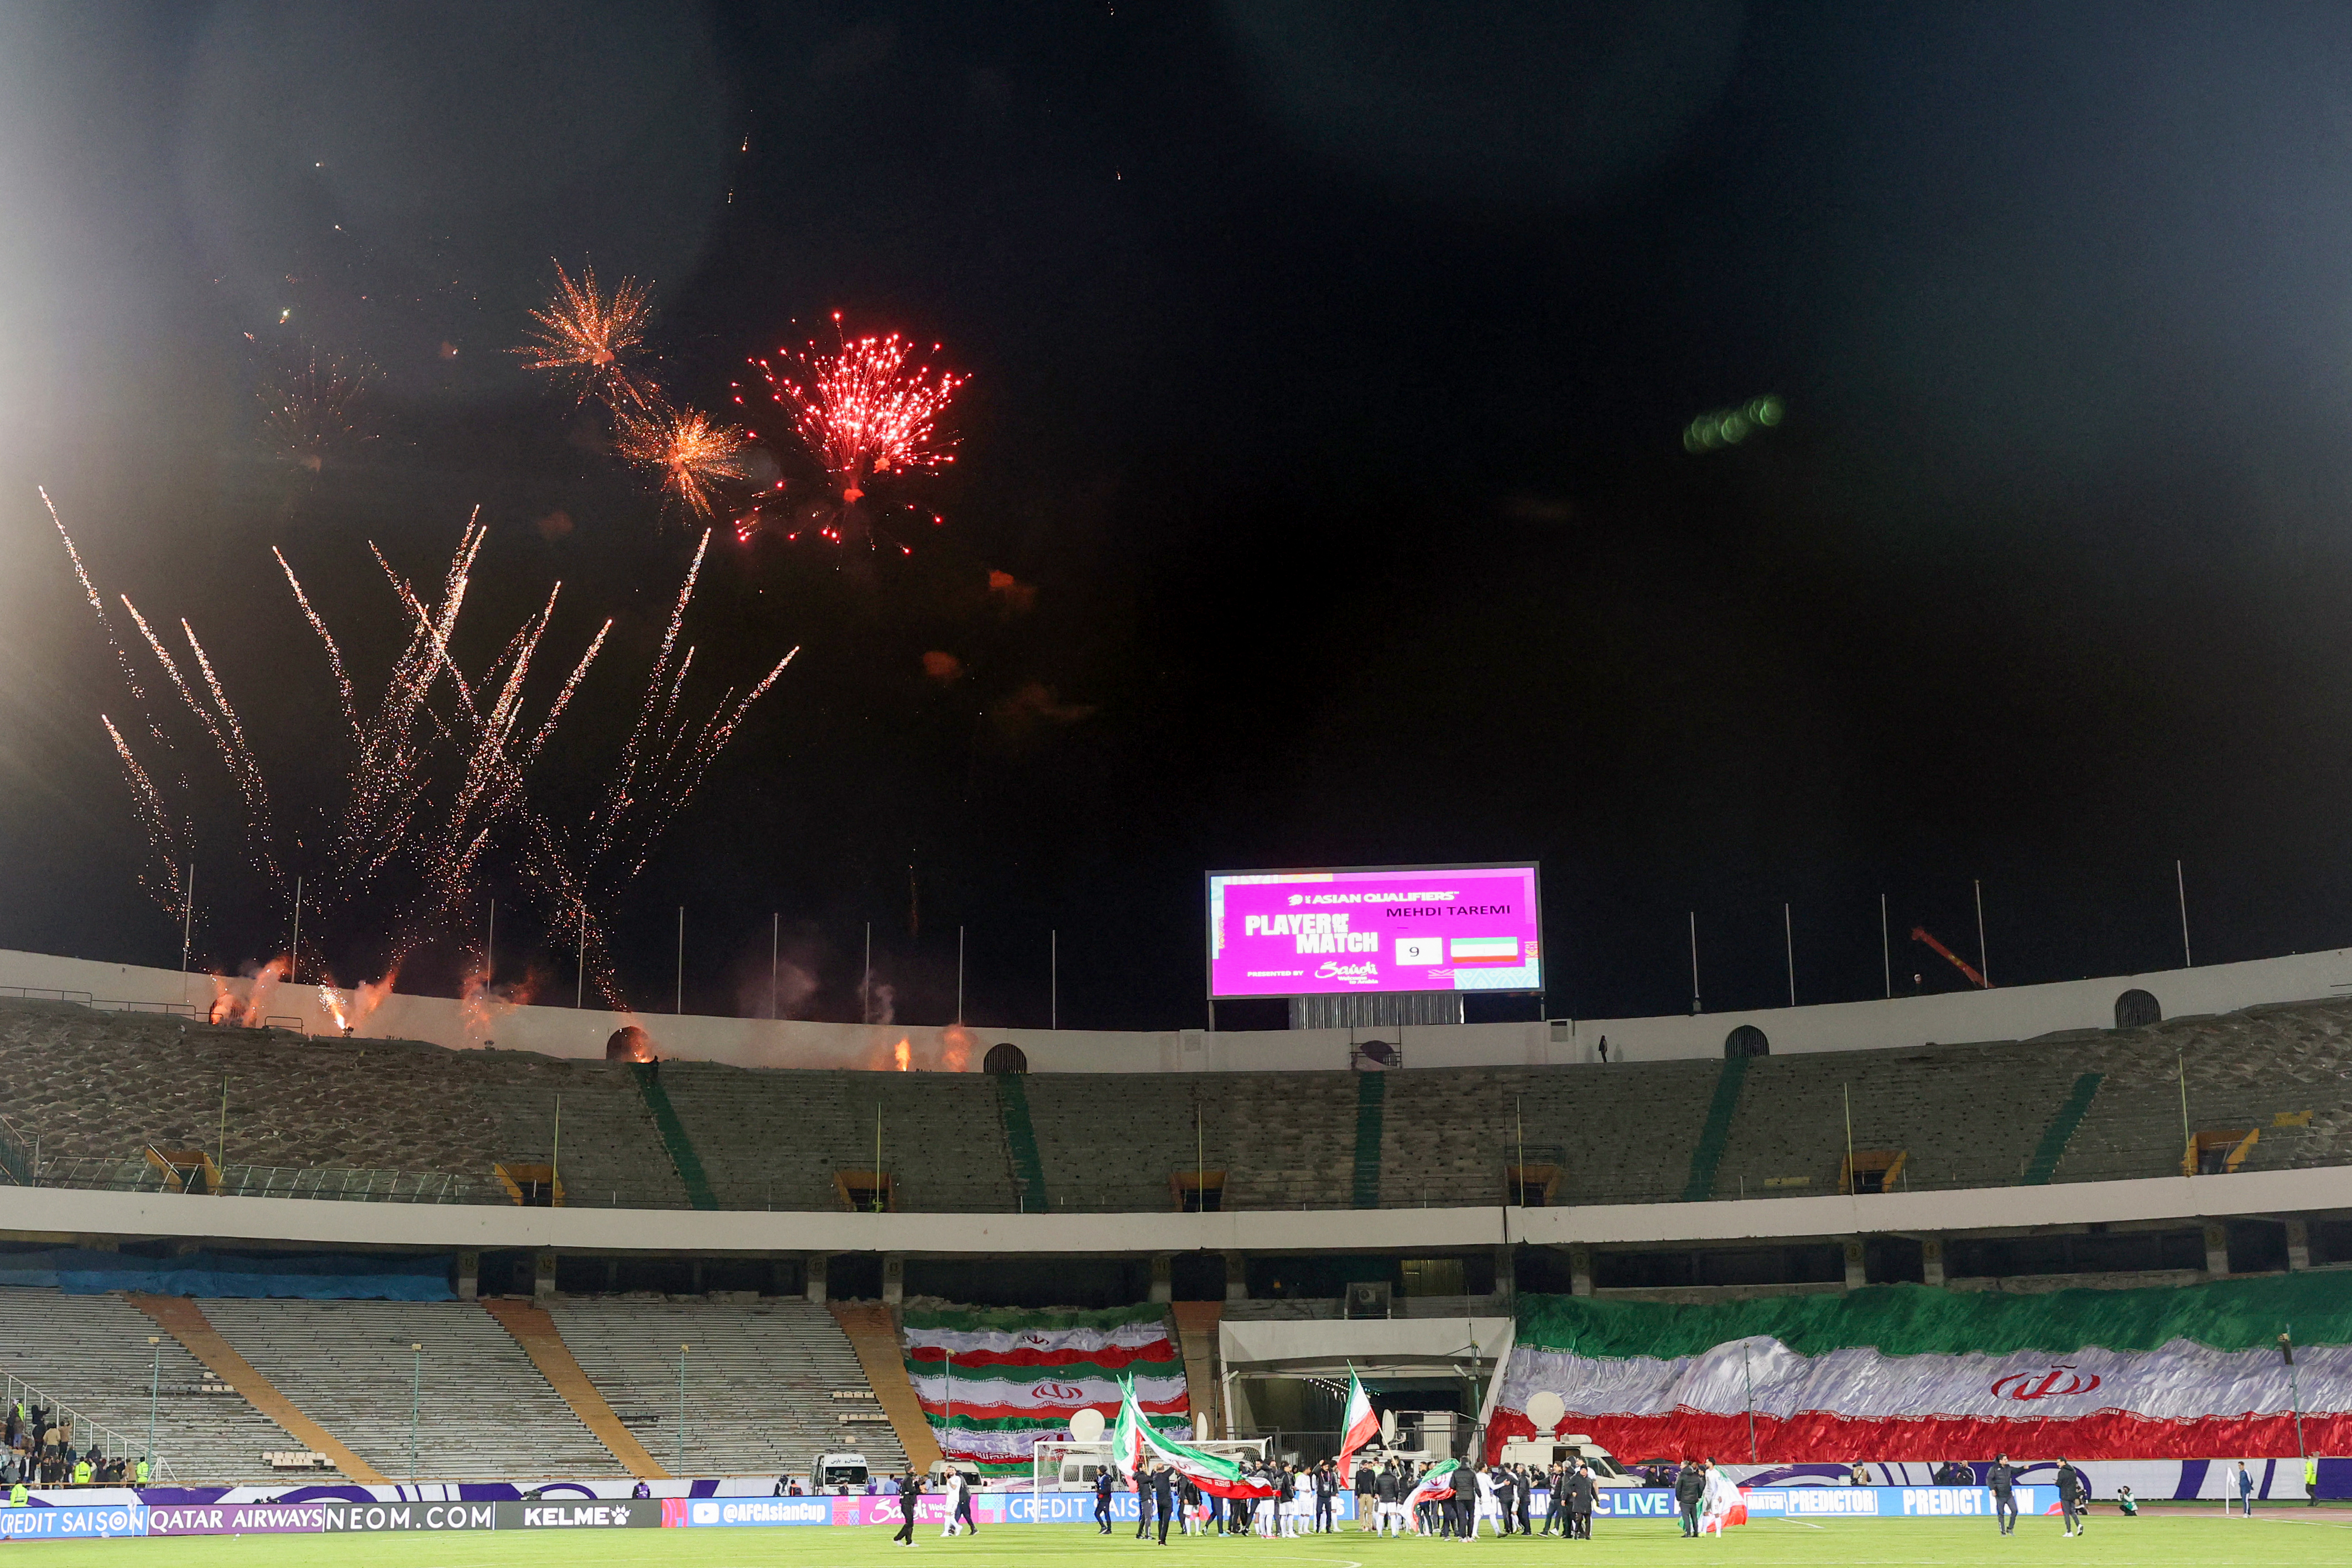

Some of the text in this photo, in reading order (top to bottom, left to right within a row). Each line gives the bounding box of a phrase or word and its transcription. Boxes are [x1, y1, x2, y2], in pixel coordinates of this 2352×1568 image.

[1312, 894, 1361, 904] ASIAN
[1332, 913, 1349, 925] OF
[1387, 905, 1510, 917] MEHDI TAREMI
[1246, 914, 1331, 936] PLAYER
[1296, 932, 1378, 954] MATCH
[1409, 946, 1419, 957] 9
[1315, 961, 1378, 978] Saudi
[870, 1498, 929, 1524] Sadi
[1010, 1498, 1087, 1519] CREDIT
[1614, 1493, 1669, 1515] LIVE
[1747, 1490, 1874, 1512] MATCH PREDICTOR
[1902, 1489, 1982, 1515] PREDICT
[1, 1511, 144, 1534] CREDIT SAISON
[150, 1509, 323, 1533] QATAR AIRWAYS
[326, 1506, 491, 1530] NEOM.COM
[524, 1507, 610, 1526] KELME
[723, 1502, 826, 1523] @AFCAsianCup
